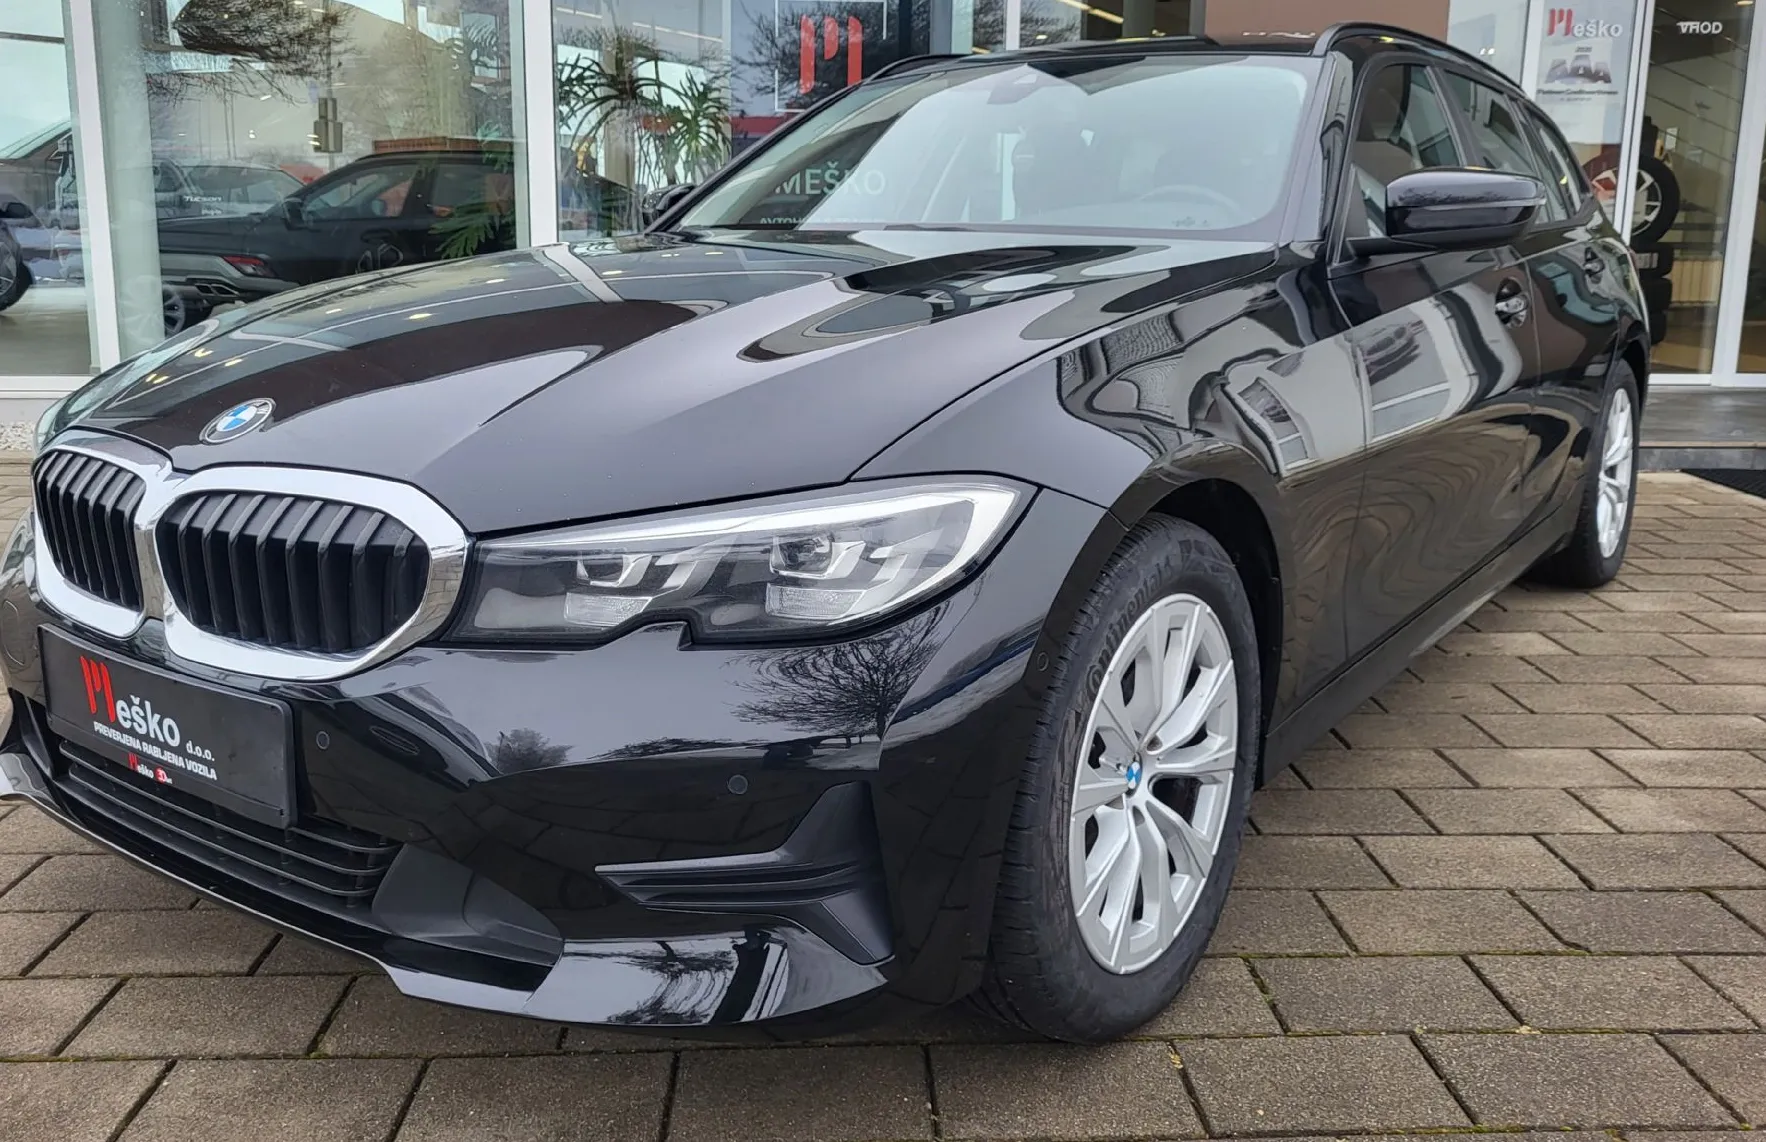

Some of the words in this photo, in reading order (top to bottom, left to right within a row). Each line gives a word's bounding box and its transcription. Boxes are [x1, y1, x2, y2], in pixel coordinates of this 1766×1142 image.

[1546, 8, 1623, 38] Meško
[1676, 21, 1723, 34] VHOD
[80, 655, 181, 747] Meško
[185, 740, 216, 762] d.o.o.
[93, 721, 141, 751] PREVERJENA
[141, 742, 185, 768] RABLJENA
[184, 758, 218, 780] VOZILA
